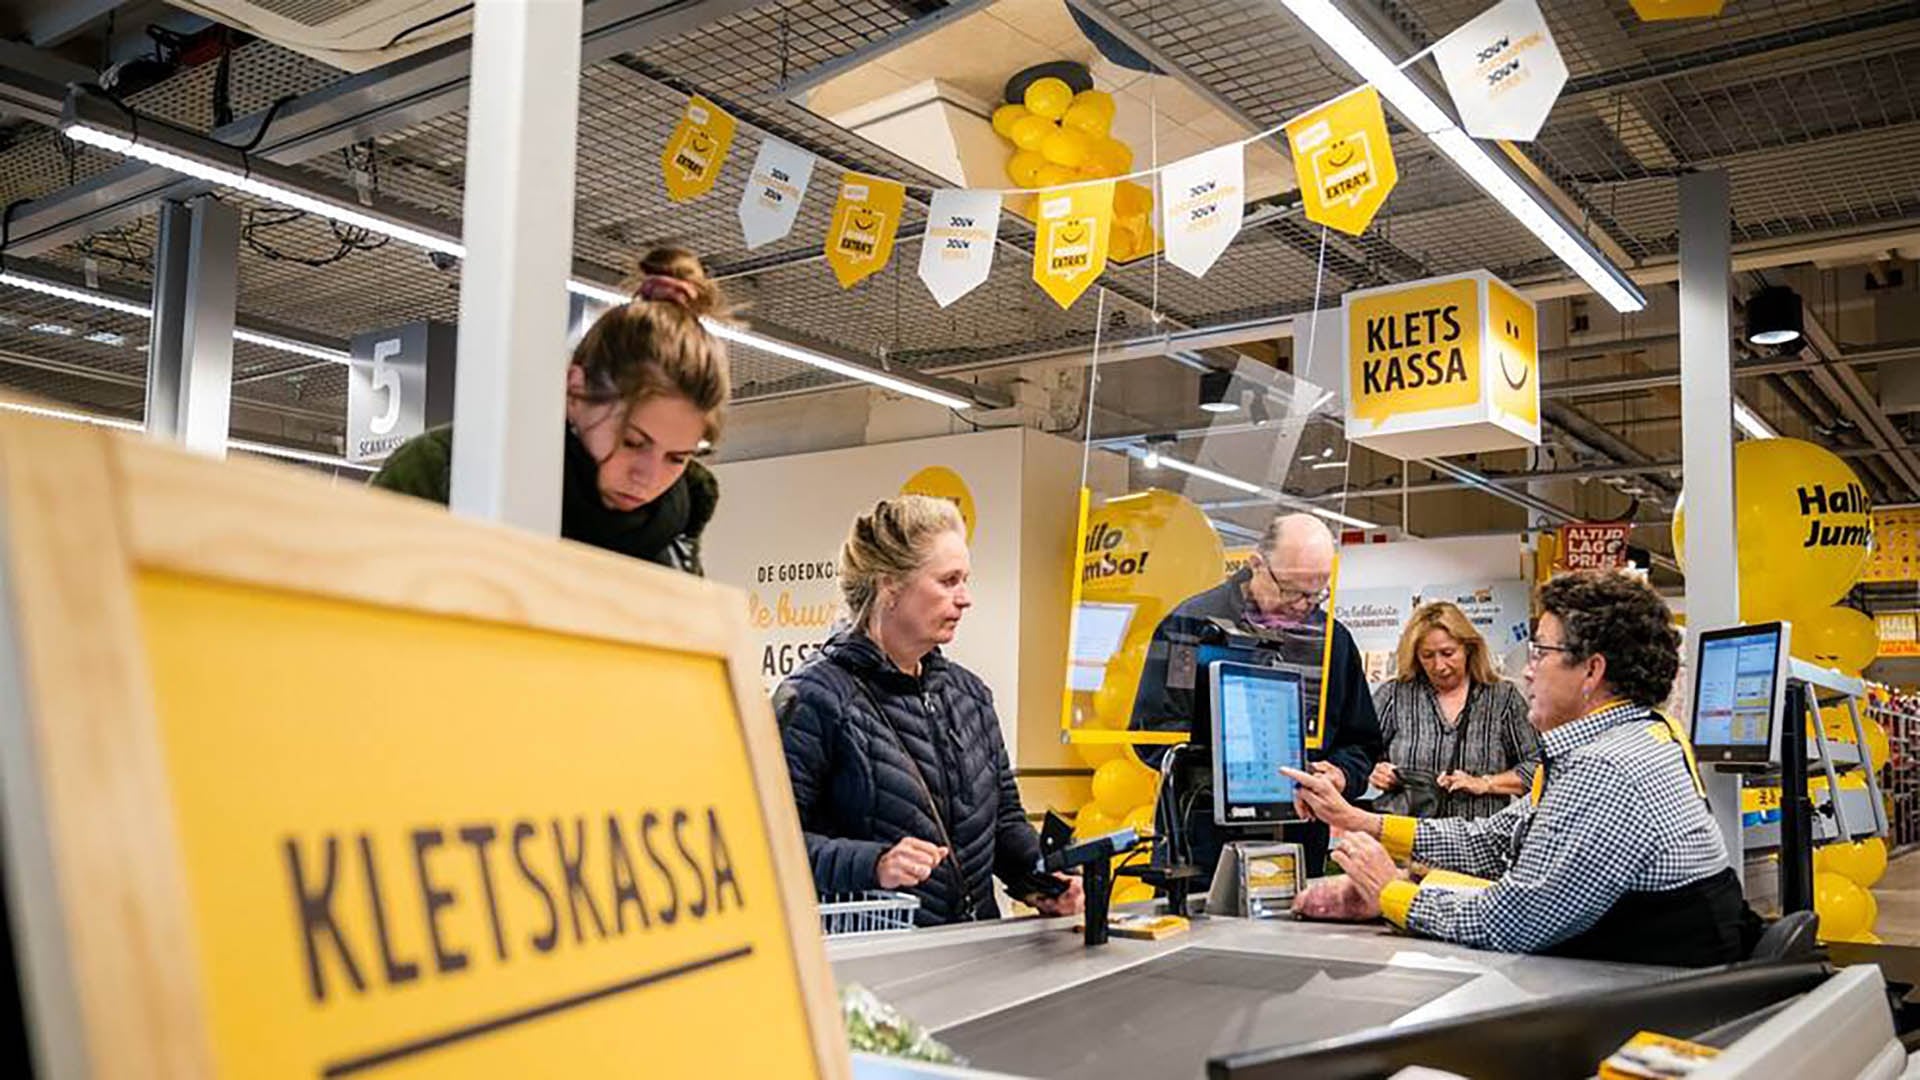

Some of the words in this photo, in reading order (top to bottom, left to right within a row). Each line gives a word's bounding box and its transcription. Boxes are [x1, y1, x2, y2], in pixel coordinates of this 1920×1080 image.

[1367, 305, 1461, 353] KLETS
[370, 337, 401, 434] 5
[1363, 347, 1467, 395] KASSA
[1568, 529, 1624, 540] ALTIJD
[757, 566, 775, 583] DE
[778, 561, 839, 582] GOEDKO
[1568, 553, 1617, 570] PRIJS
[282, 806, 745, 1003] KLETSKASSA
